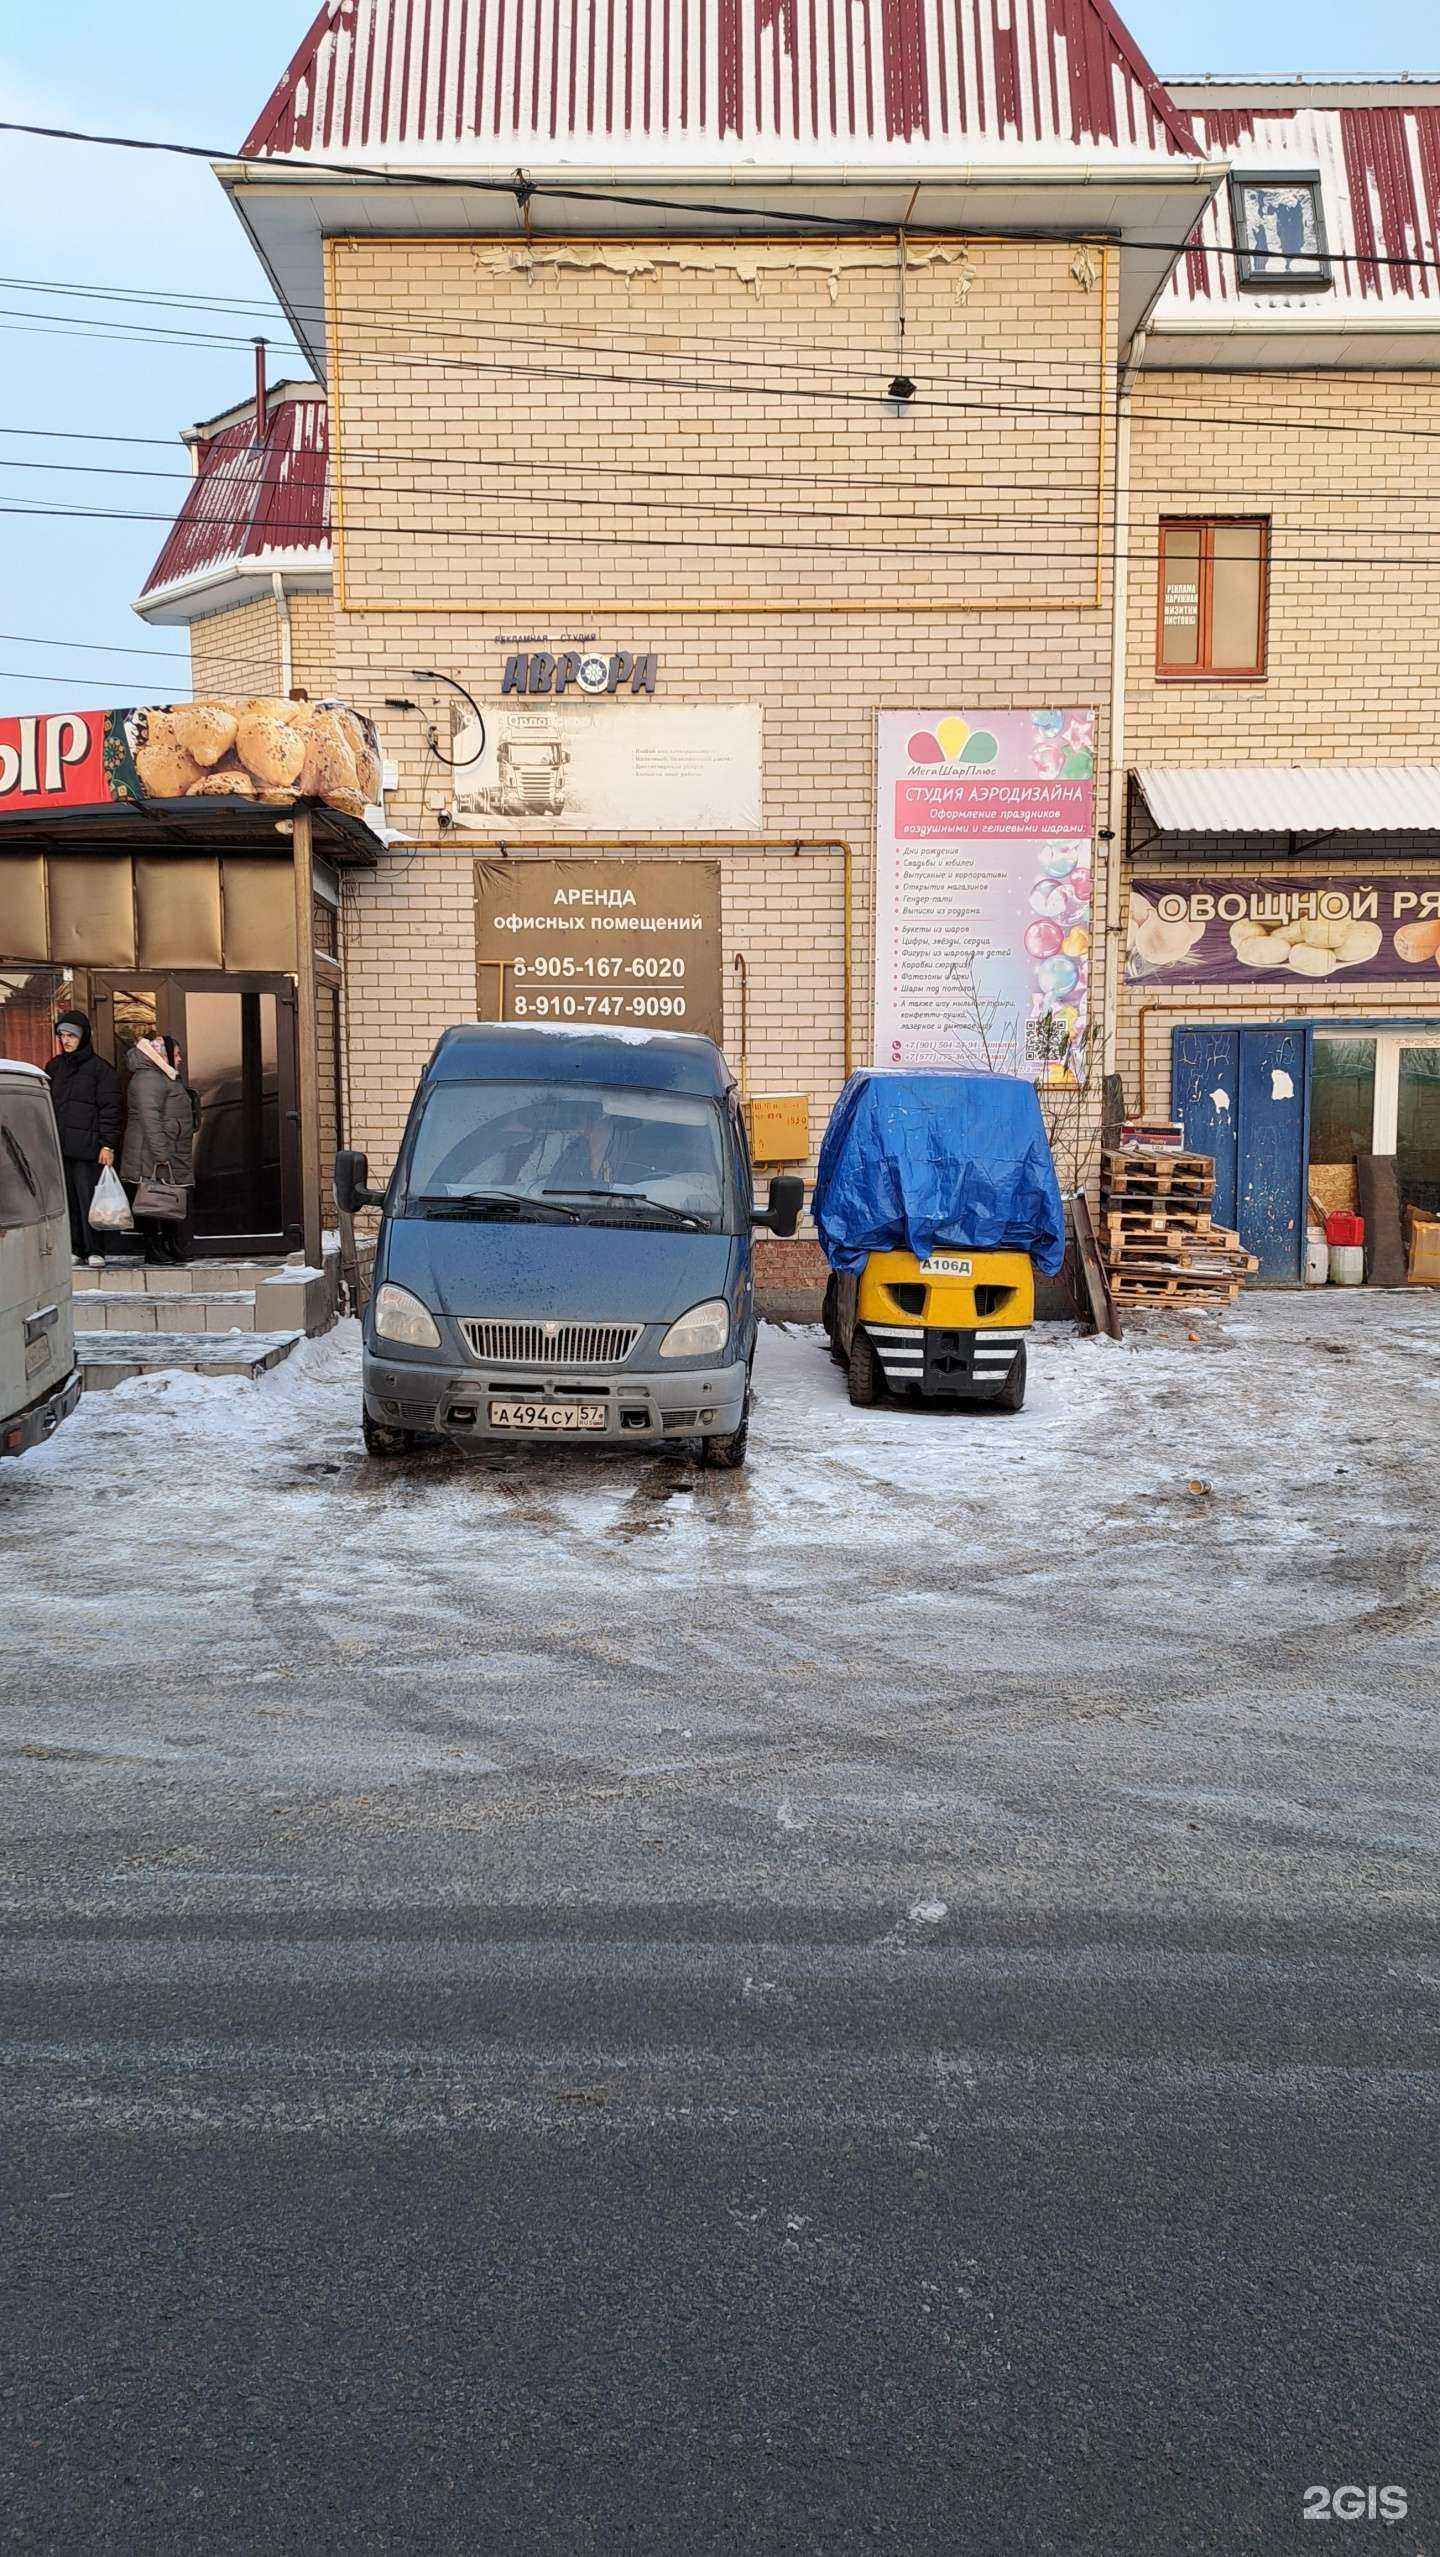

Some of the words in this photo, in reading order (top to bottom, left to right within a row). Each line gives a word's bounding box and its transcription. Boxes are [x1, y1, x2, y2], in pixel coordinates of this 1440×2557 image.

[905, 786, 964, 803] СТУДИЯ
[968, 784, 1083, 803] АЭРОДИЗАЙНА
[929, 808, 999, 820] Оформление
[1000, 810, 1061, 823] праздников
[904, 825, 969, 837] воздушными
[972, 825, 979, 834] и
[981, 825, 1038, 834] гелиевыми
[903, 847, 918, 857] Дни
[921, 848, 959, 858] рождения
[903, 859, 935, 869] Свадьбы
[903, 871, 946, 879] Выпускные
[955, 872, 1008, 880] корпоративы
[553, 889, 637, 908] АРЕНДА
[1157, 885, 1378, 925] ОВОЩНОЙ
[902, 907, 935, 915] Выписки
[947, 908, 981, 917] роддома
[494, 913, 585, 932] офисных
[591, 914, 703, 931] помещений
[901, 925, 931, 935] Букеты
[945, 926, 970, 934] шаров
[963, 938, 990, 947] сердца
[901, 949, 931, 957] Фигуры
[986, 948, 1011, 959] детей
[513, 957, 685, 977] 8-905-167-6020
[901, 961, 933, 969] Коробки
[901, 973, 943, 981] Фотозоны
[926, 985, 940, 995] под
[514, 996, 686, 1016] 8-910-747-9090
[921, 1258, 970, 1274] А106Д
[580, 1407, 599, 1420] 57
